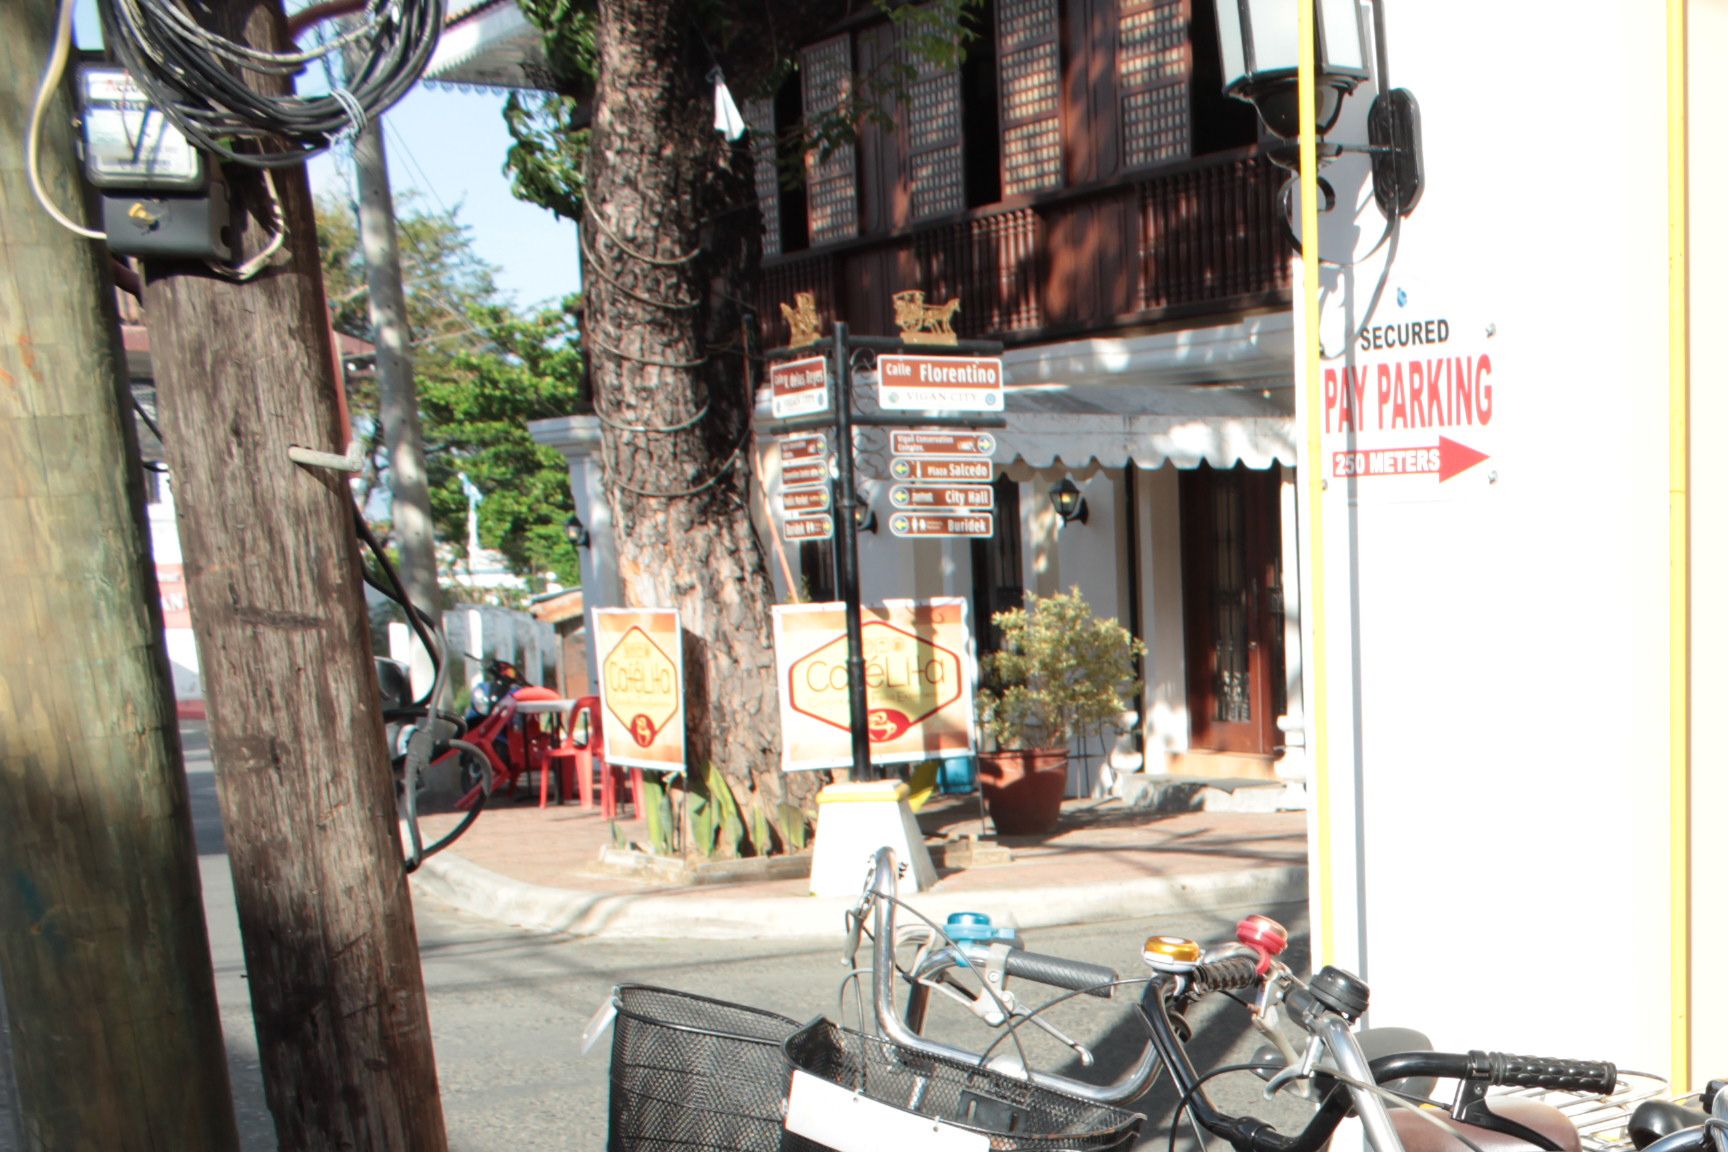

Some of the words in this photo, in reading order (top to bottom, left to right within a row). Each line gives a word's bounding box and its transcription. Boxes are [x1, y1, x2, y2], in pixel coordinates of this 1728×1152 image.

[1360, 318, 1450, 351] SECURED
[885, 362, 912, 376] Calle
[919, 362, 997, 384] Florentino
[1324, 364, 1368, 434] PAY
[1377, 353, 1493, 431] PARKING
[948, 462, 988, 477] Salcedo
[1335, 452, 1366, 476] 250
[1369, 448, 1441, 474] METERS
[945, 489, 966, 506] City
[967, 490, 989, 504] Hall
